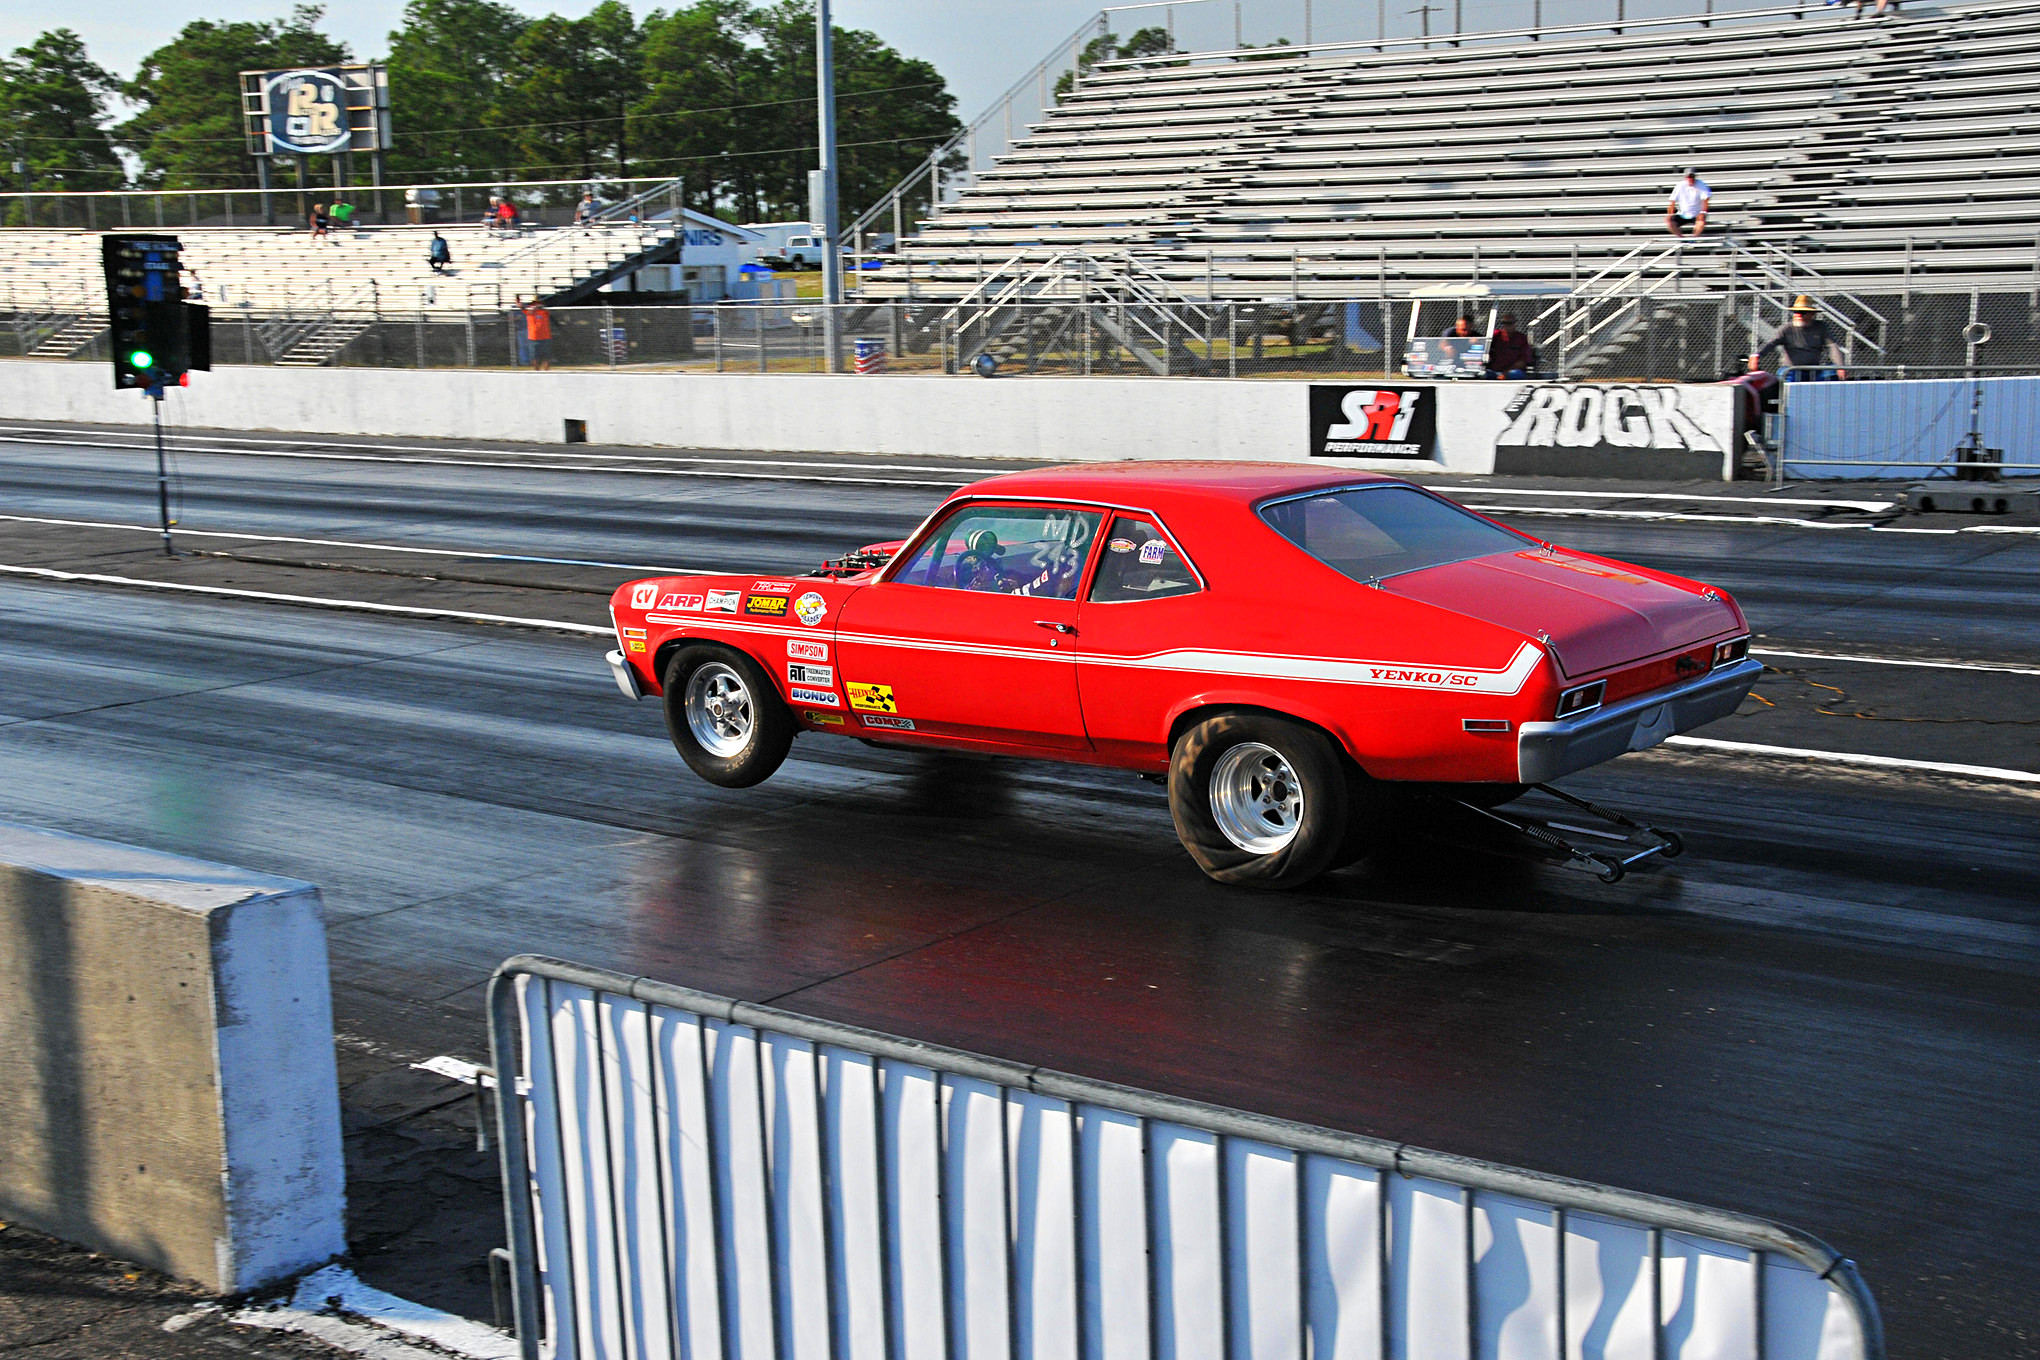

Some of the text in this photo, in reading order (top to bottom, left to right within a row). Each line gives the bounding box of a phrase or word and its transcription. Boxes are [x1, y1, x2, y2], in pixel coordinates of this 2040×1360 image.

[1495, 385, 1723, 452] ROCK
[1324, 441, 1421, 454] PERFORMANCE
[1143, 545, 1165, 560] FARM
[636, 589, 654, 604] CV
[660, 594, 703, 608] ARP
[709, 596, 736, 606] CHAMPION
[746, 595, 788, 610] JOMAR
[790, 643, 824, 658] SIMPSON
[789, 664, 806, 682] ATI
[1370, 668, 1479, 687] YENKO/SC
[792, 689, 836, 703] BIONDO
[866, 716, 902, 726] COMP
